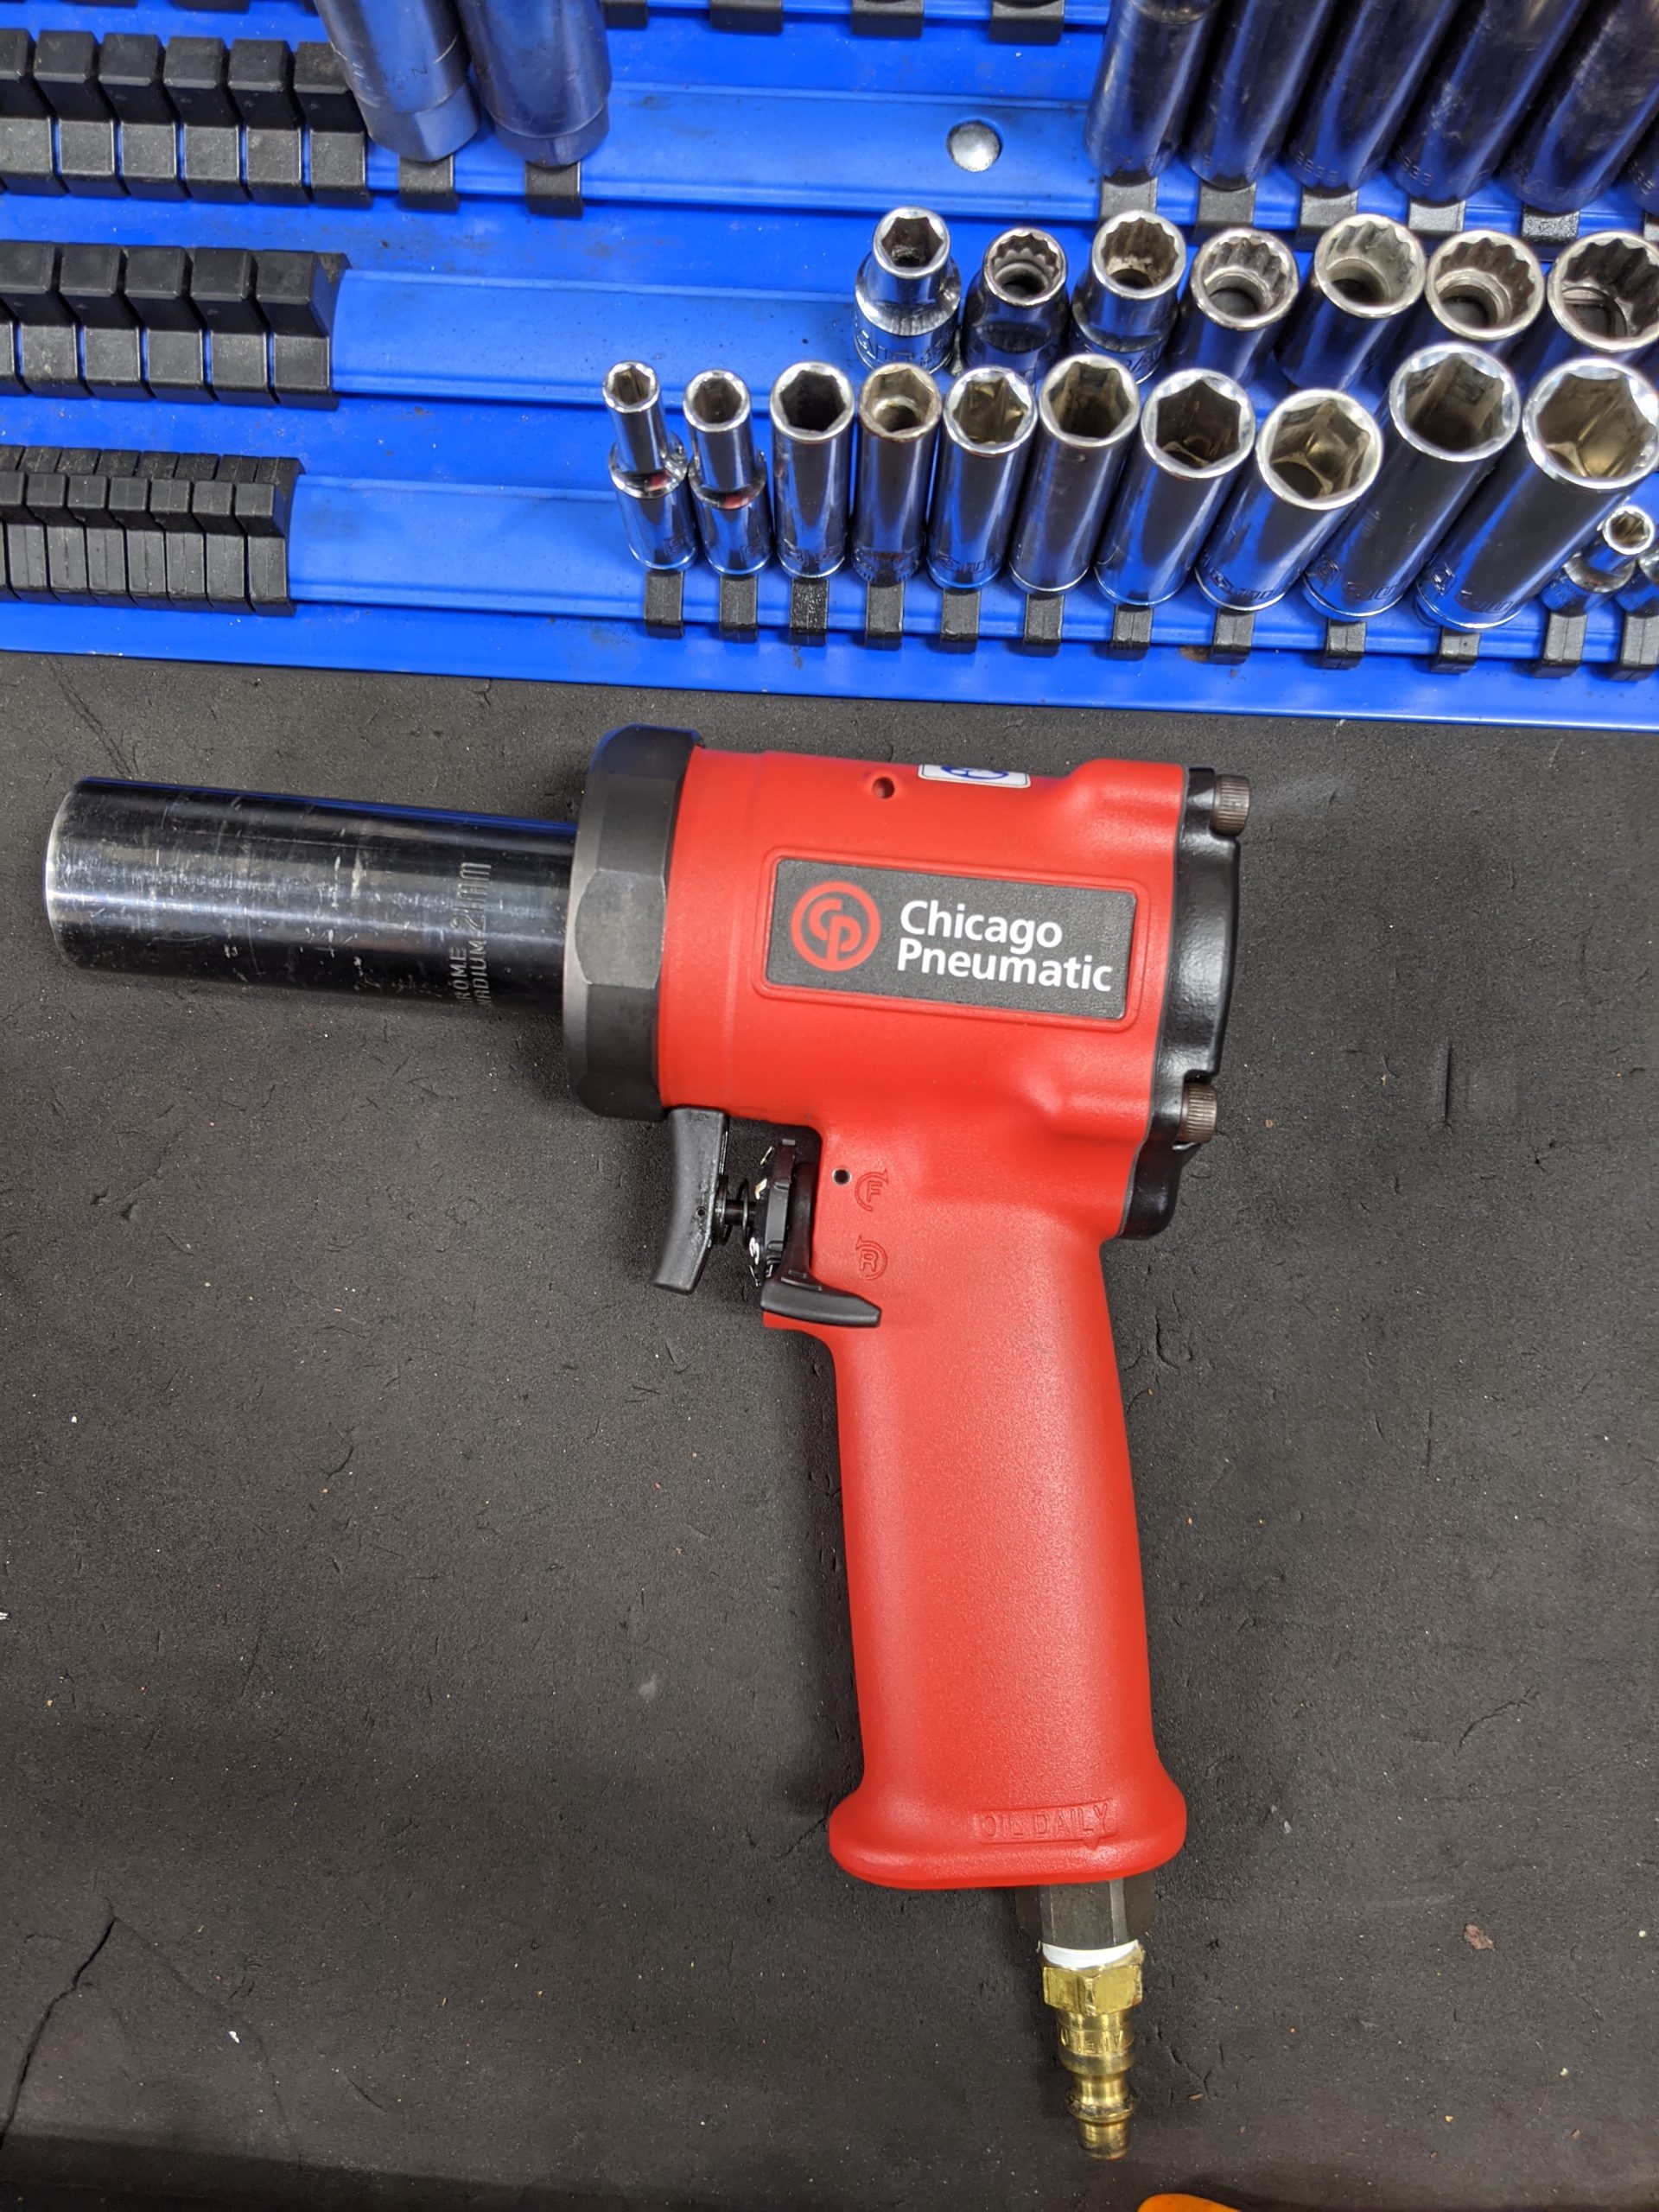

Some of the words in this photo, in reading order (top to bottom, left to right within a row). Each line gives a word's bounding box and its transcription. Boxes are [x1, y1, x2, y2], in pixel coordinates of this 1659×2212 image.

[899, 899, 1063, 954] Chicago
[897, 938, 1113, 992] Pneumatic
[982, 1813, 1025, 1839] OIL
[1033, 1802, 1109, 1838] DAILY
